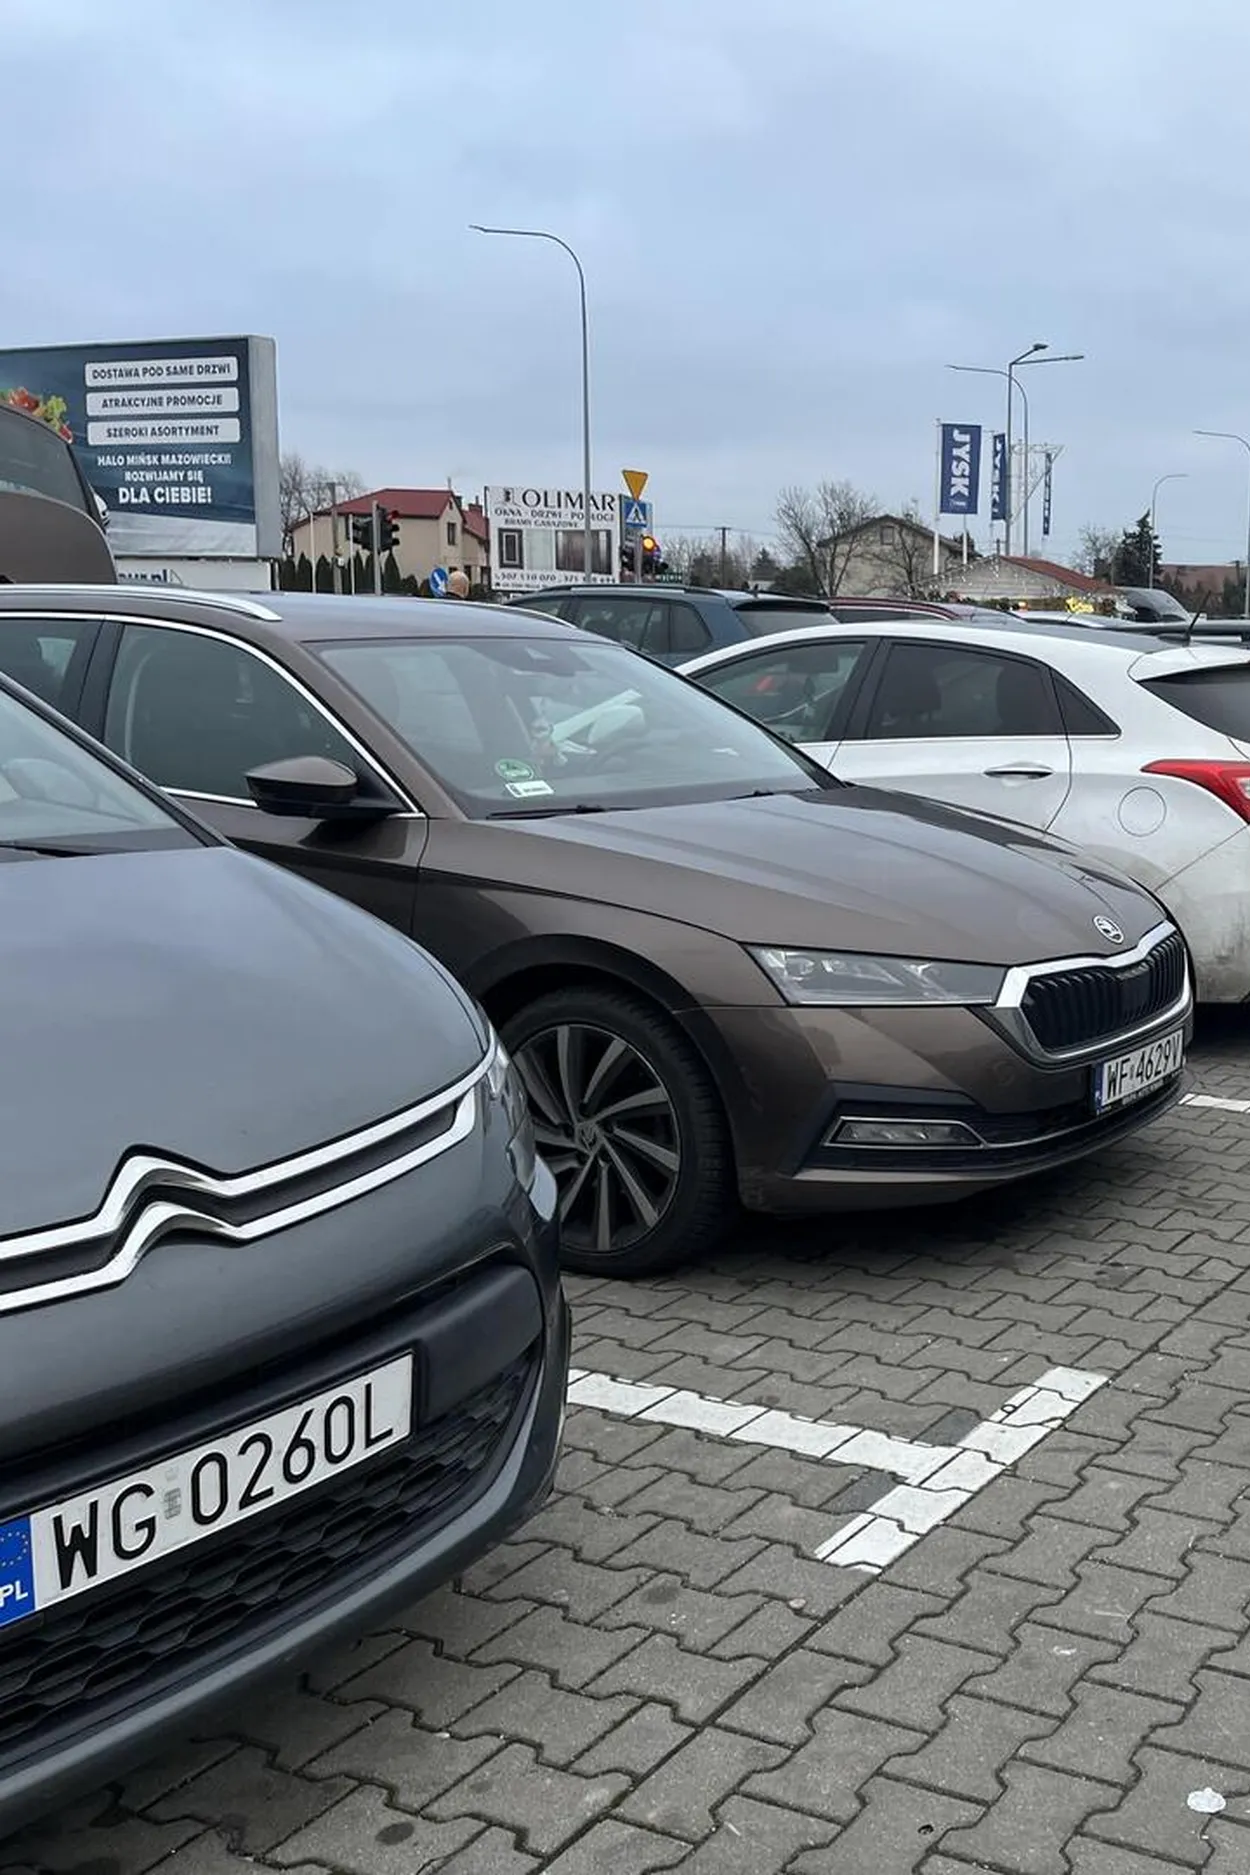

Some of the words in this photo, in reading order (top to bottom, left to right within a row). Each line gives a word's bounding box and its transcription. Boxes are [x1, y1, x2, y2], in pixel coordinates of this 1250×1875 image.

[92, 368, 140, 379] DOSTAWA
[142, 367, 164, 377] POD
[166, 365, 194, 376] SAME
[197, 363, 231, 375] DRZWI
[102, 397, 164, 409] ATRAKCYJNE
[167, 395, 223, 406] PROMOCJE
[106, 427, 148, 438] SZEROKI
[150, 425, 219, 437] ASORTYMENT
[98, 455, 125, 466] HALO
[950, 428, 971, 498] JYSK
[125, 470, 184, 482] ROZWIJAMY
[187, 470, 204, 483] SIĘ
[119, 487, 151, 503] DLA
[154, 486, 212, 504] CIEBIE!
[522, 488, 616, 511] OLIMAR
[1107, 1057, 1131, 1100] WF
[52, 1482, 158, 1591] WG
[190, 1382, 394, 1526] 0260L
[0, 1579, 29, 1608] PL
